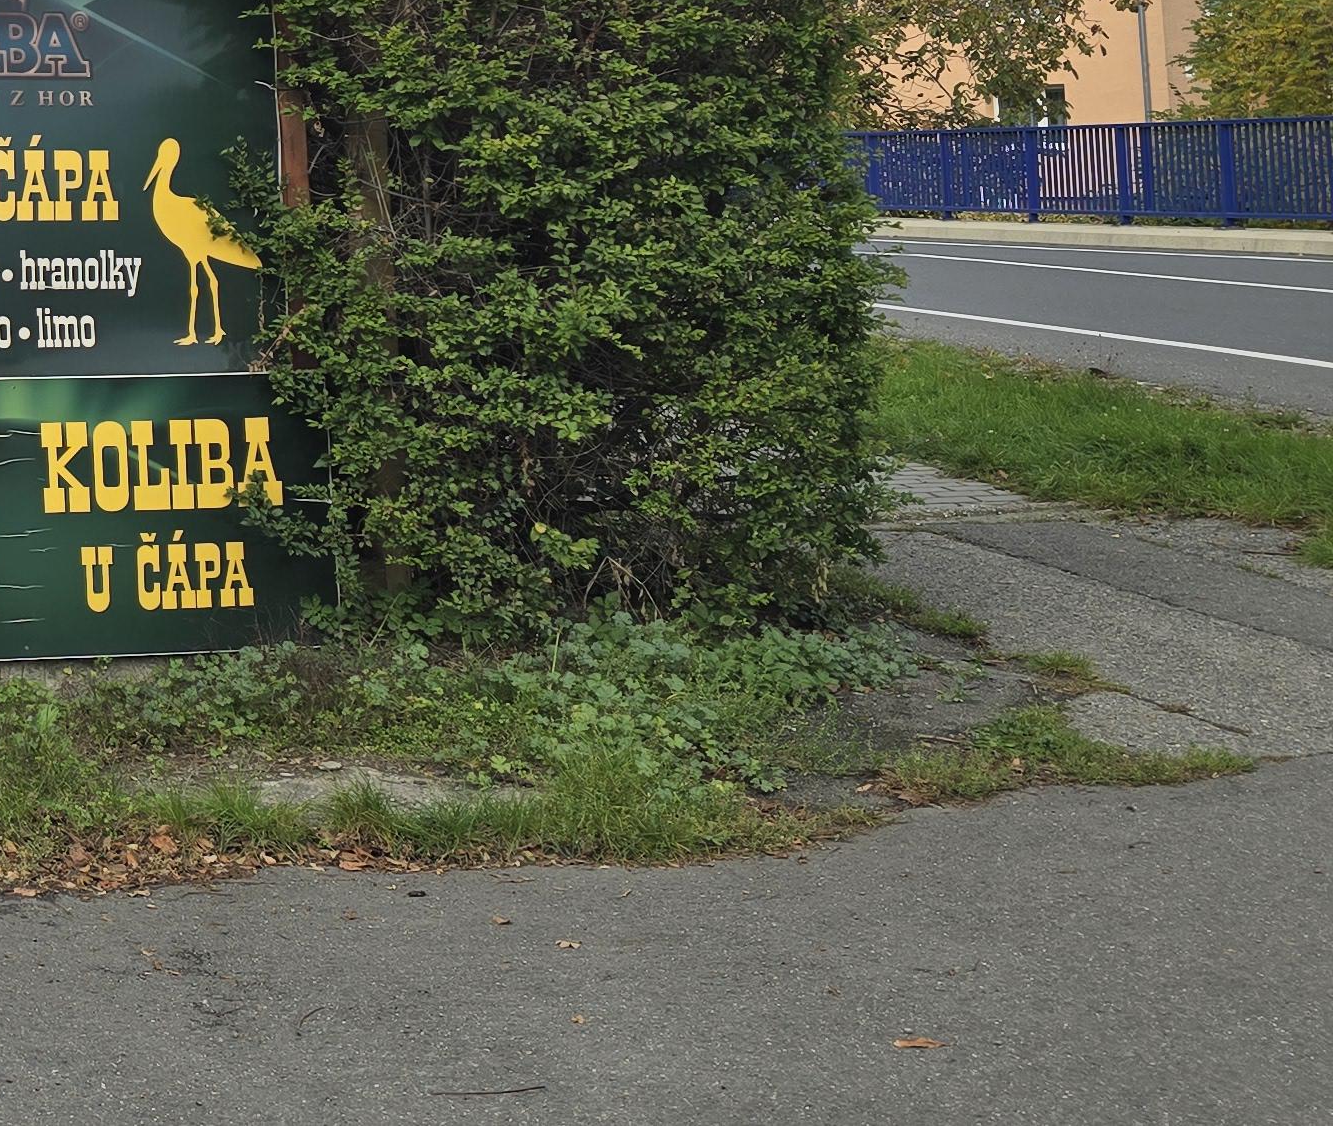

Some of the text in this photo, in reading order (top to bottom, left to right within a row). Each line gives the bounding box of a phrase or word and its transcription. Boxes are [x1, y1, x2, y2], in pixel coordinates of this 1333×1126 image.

[10, 90, 26, 106] Z
[38, 90, 94, 106] HOR
[20, 249, 141, 297] hranolky
[36, 307, 96, 349] limo
[40, 416, 283, 514] KOLIBA
[81, 530, 255, 613] U ČÁPA
